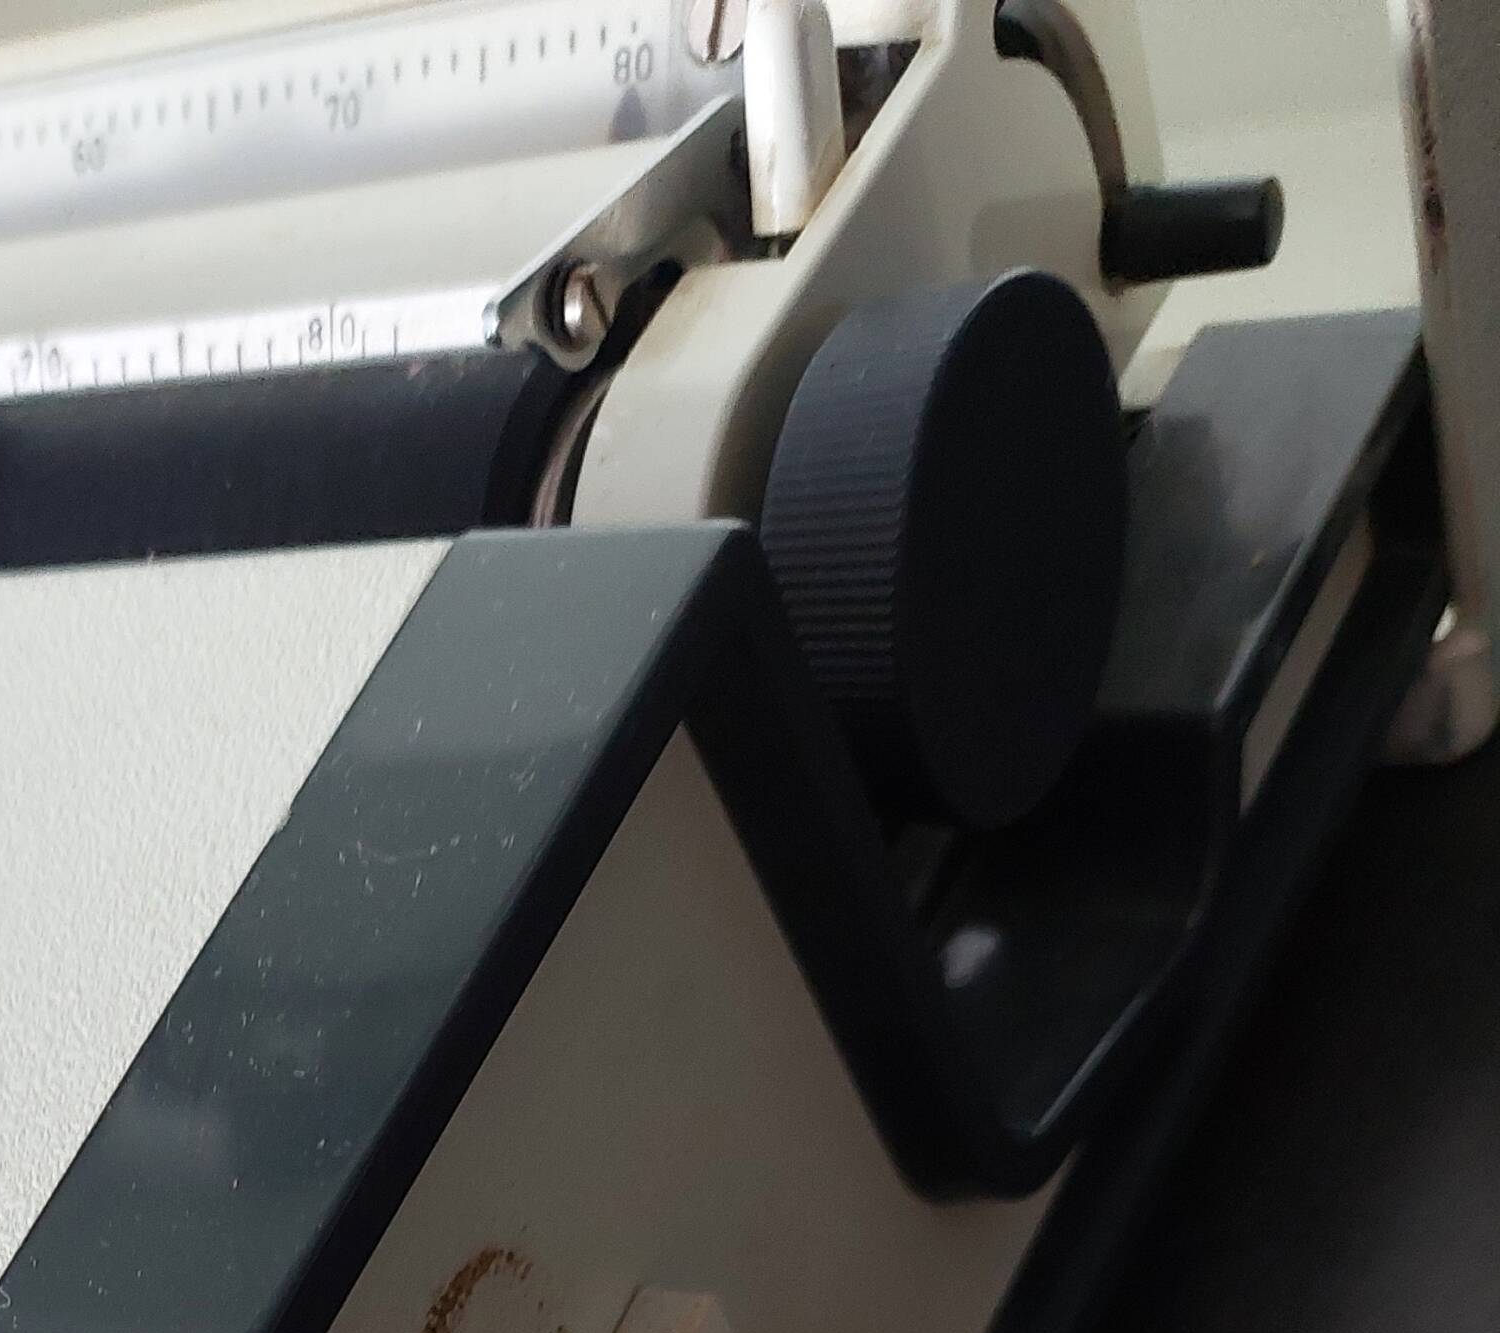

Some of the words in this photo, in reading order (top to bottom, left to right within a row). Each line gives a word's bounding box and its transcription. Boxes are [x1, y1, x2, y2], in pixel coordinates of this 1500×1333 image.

[325, 90, 361, 129] 70
[613, 43, 654, 84] 80
[308, 314, 356, 354] 80
